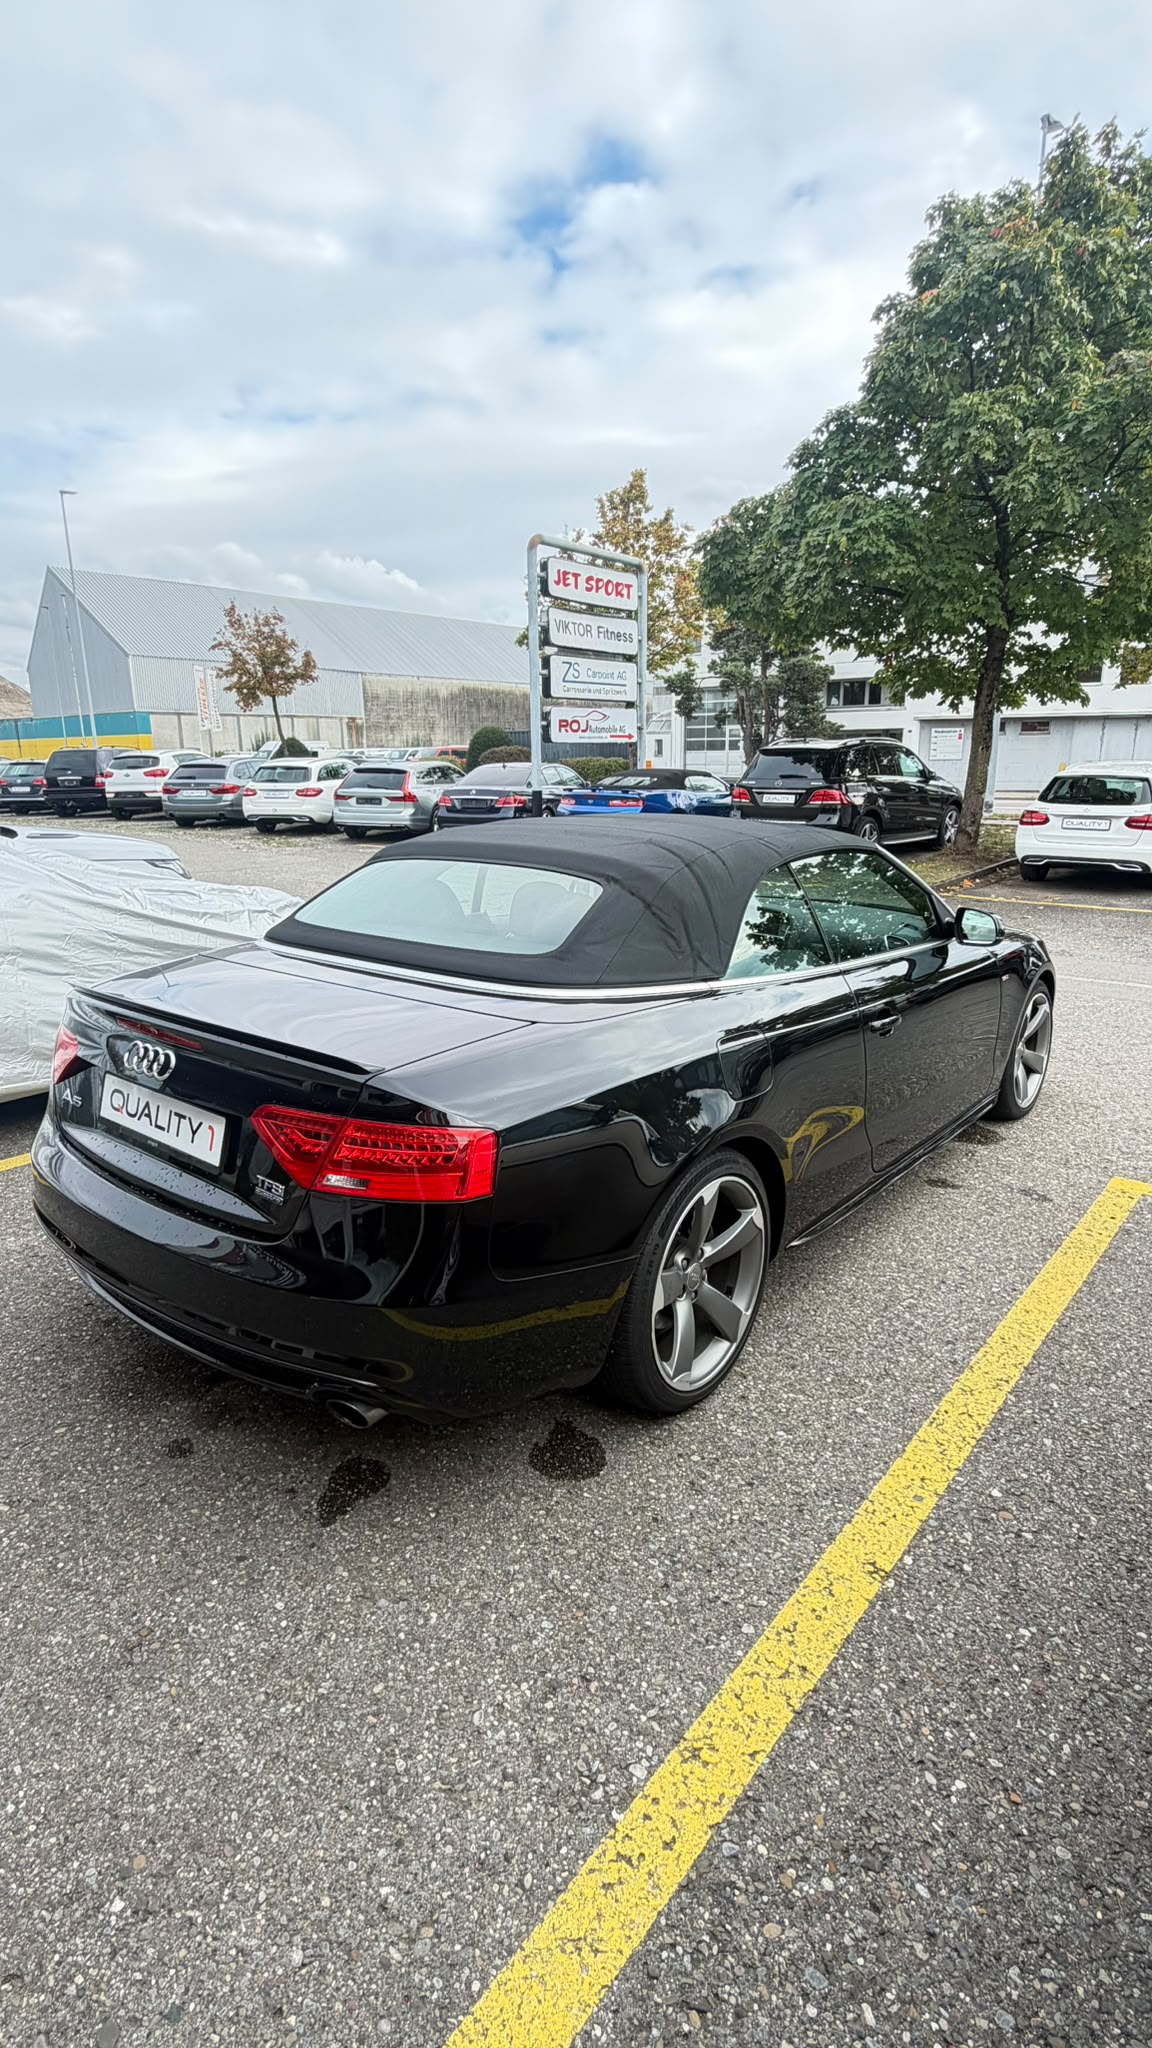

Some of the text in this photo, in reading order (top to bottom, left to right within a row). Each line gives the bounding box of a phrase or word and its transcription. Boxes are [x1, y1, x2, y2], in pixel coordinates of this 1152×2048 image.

[554, 569, 633, 600] JET SPORT
[554, 618, 633, 643] VIKTOR Fitness
[586, 667, 627, 681] Carpoint AG
[558, 719, 589, 733] ROJ
[589, 725, 626, 734] Automobile AG
[61, 1088, 82, 1107] A5
[256, 1174, 285, 1197] TFSI
